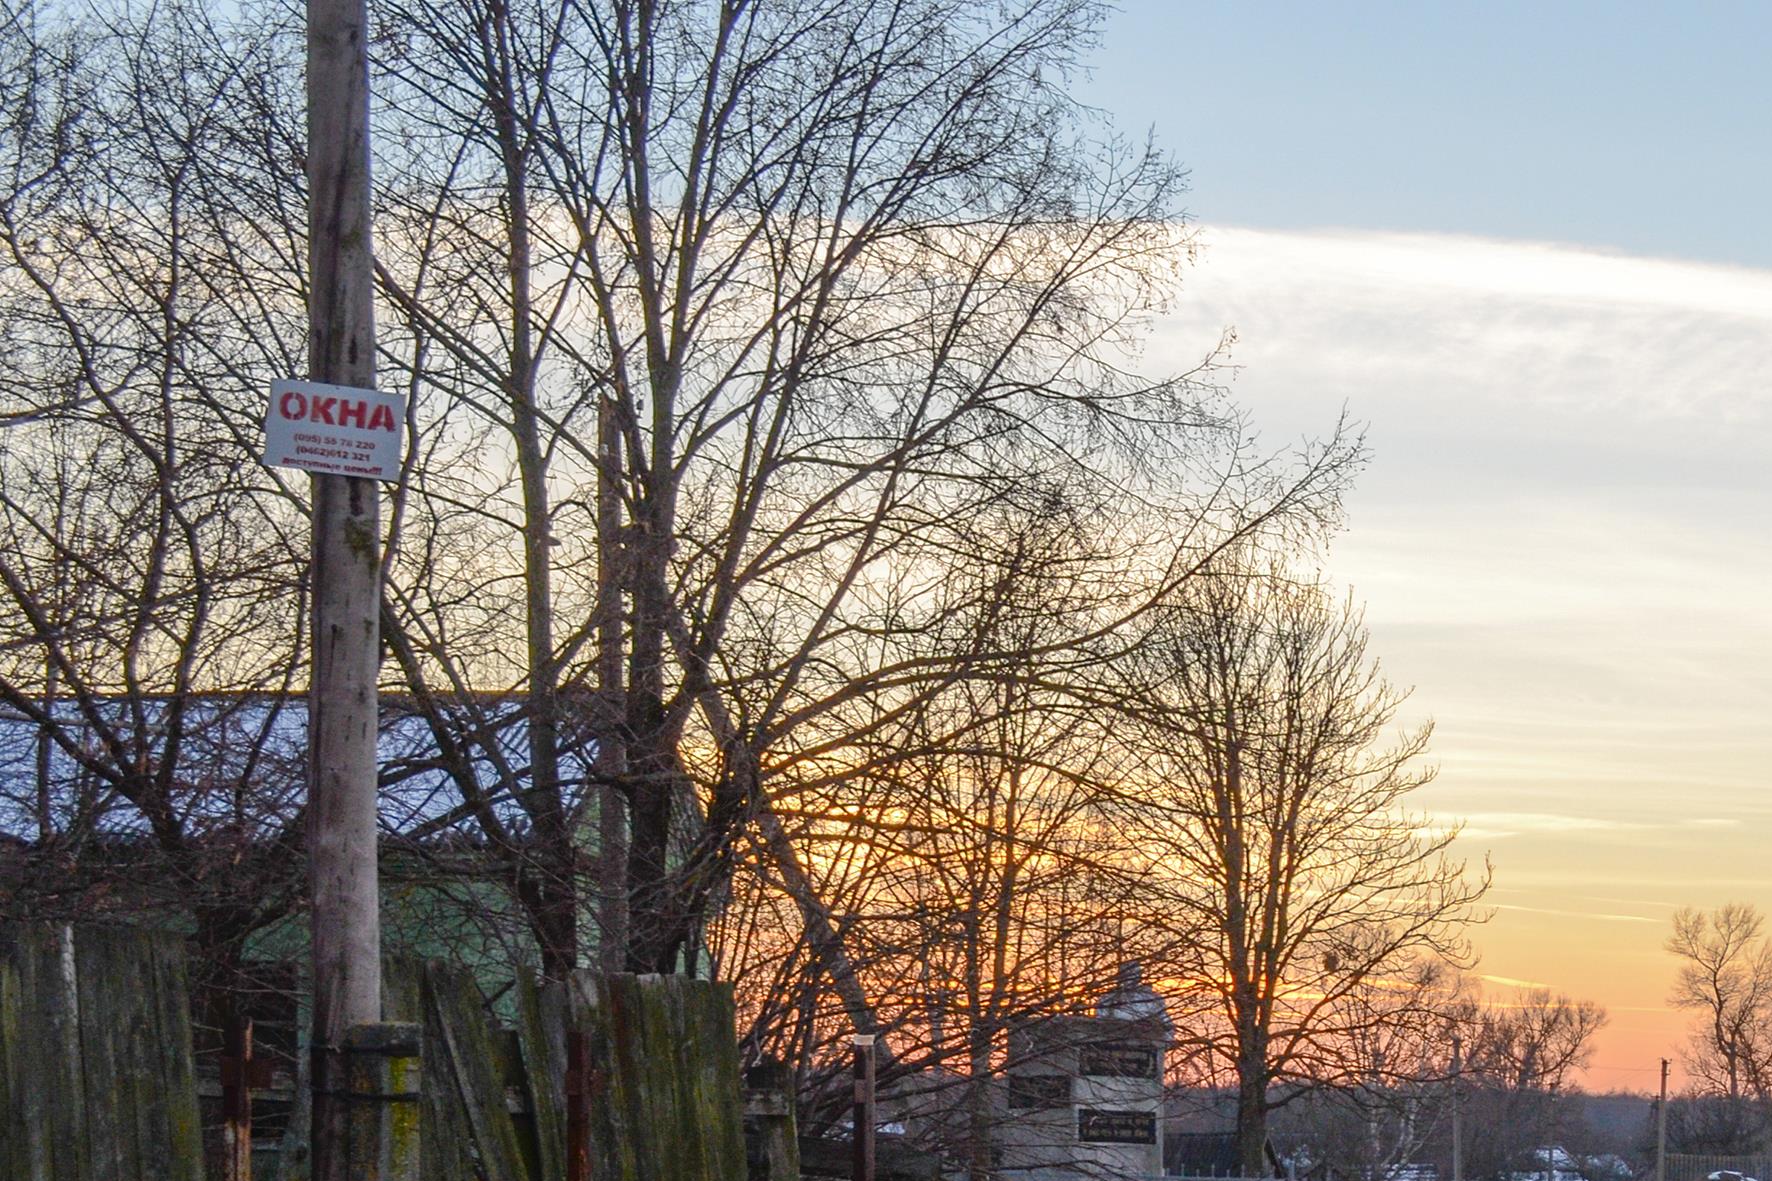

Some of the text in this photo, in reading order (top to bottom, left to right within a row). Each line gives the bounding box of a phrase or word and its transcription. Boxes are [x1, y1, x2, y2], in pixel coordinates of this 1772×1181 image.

[280, 392, 396, 432] ОКНА
[294, 433, 321, 445] (095)
[356, 441, 375, 450] 220
[351, 452, 371, 462] 321
